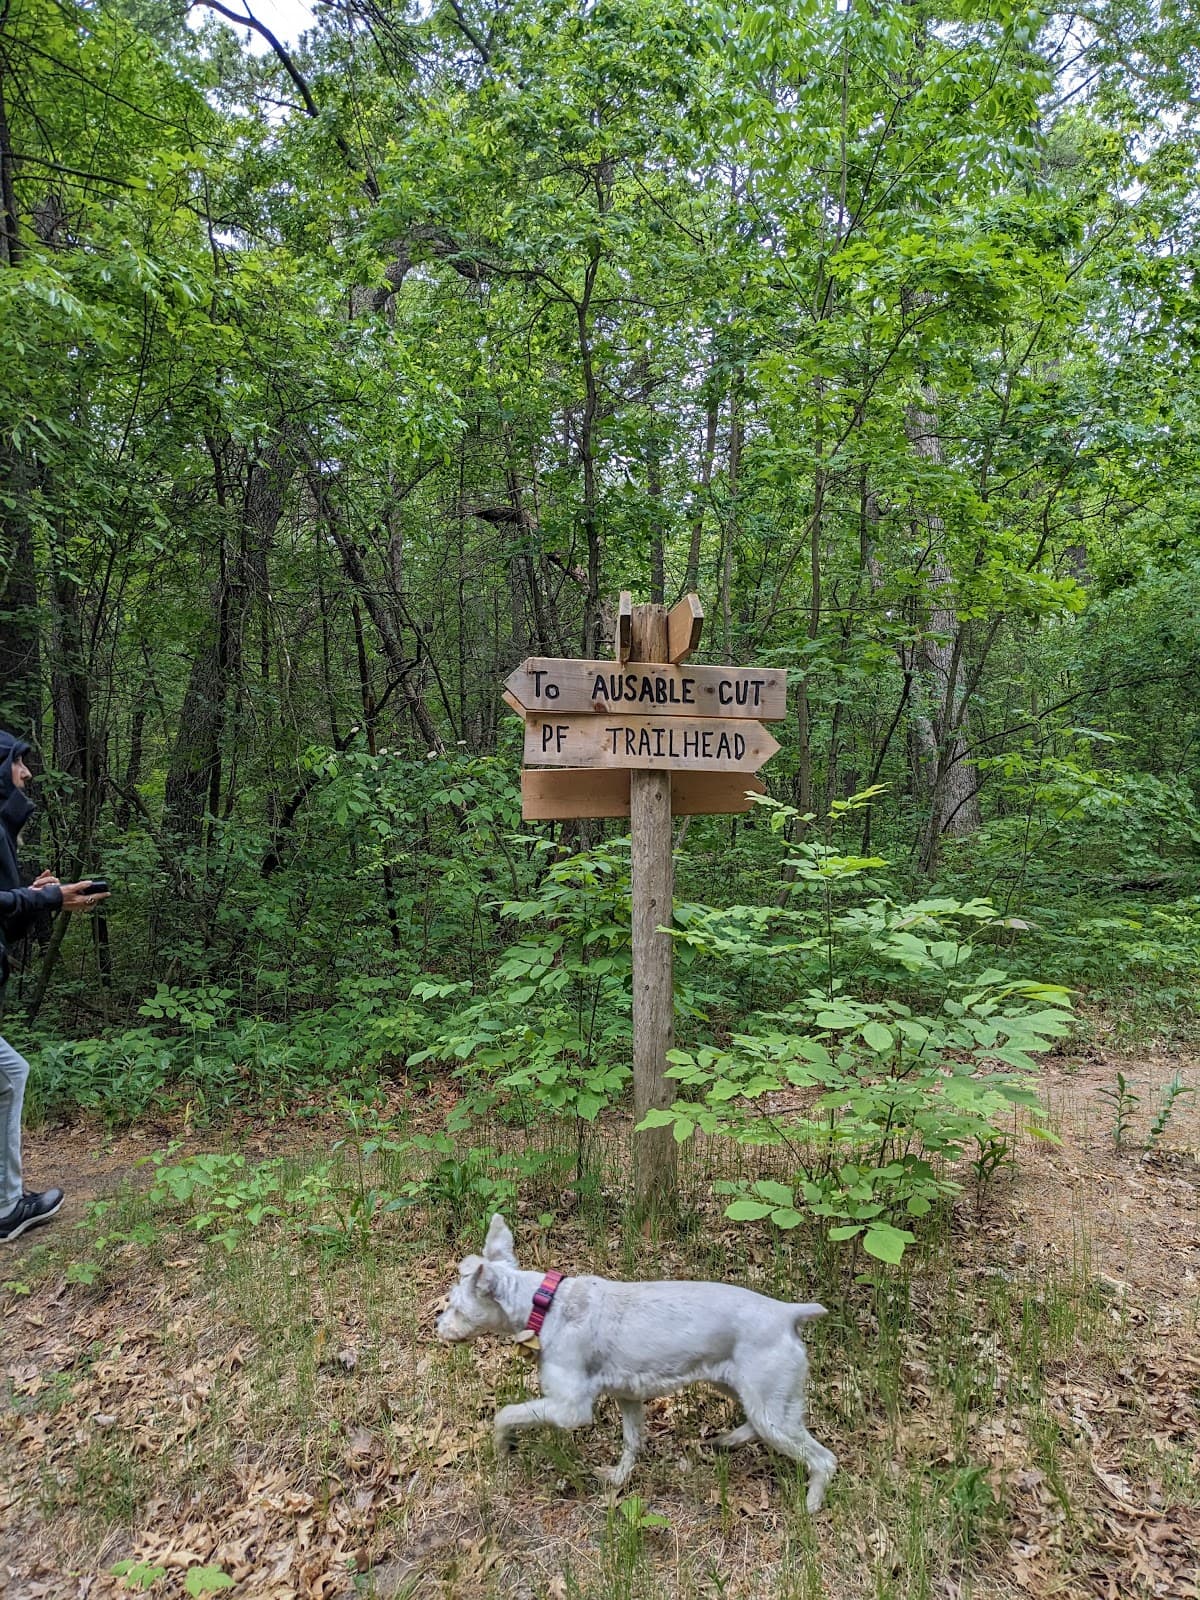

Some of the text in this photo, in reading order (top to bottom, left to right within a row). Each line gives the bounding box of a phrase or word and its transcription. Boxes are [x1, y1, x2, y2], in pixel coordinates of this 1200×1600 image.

[532, 671, 765, 706] To AUSABLE CUT
[542, 724, 746, 760] PF TRAILHEAD
